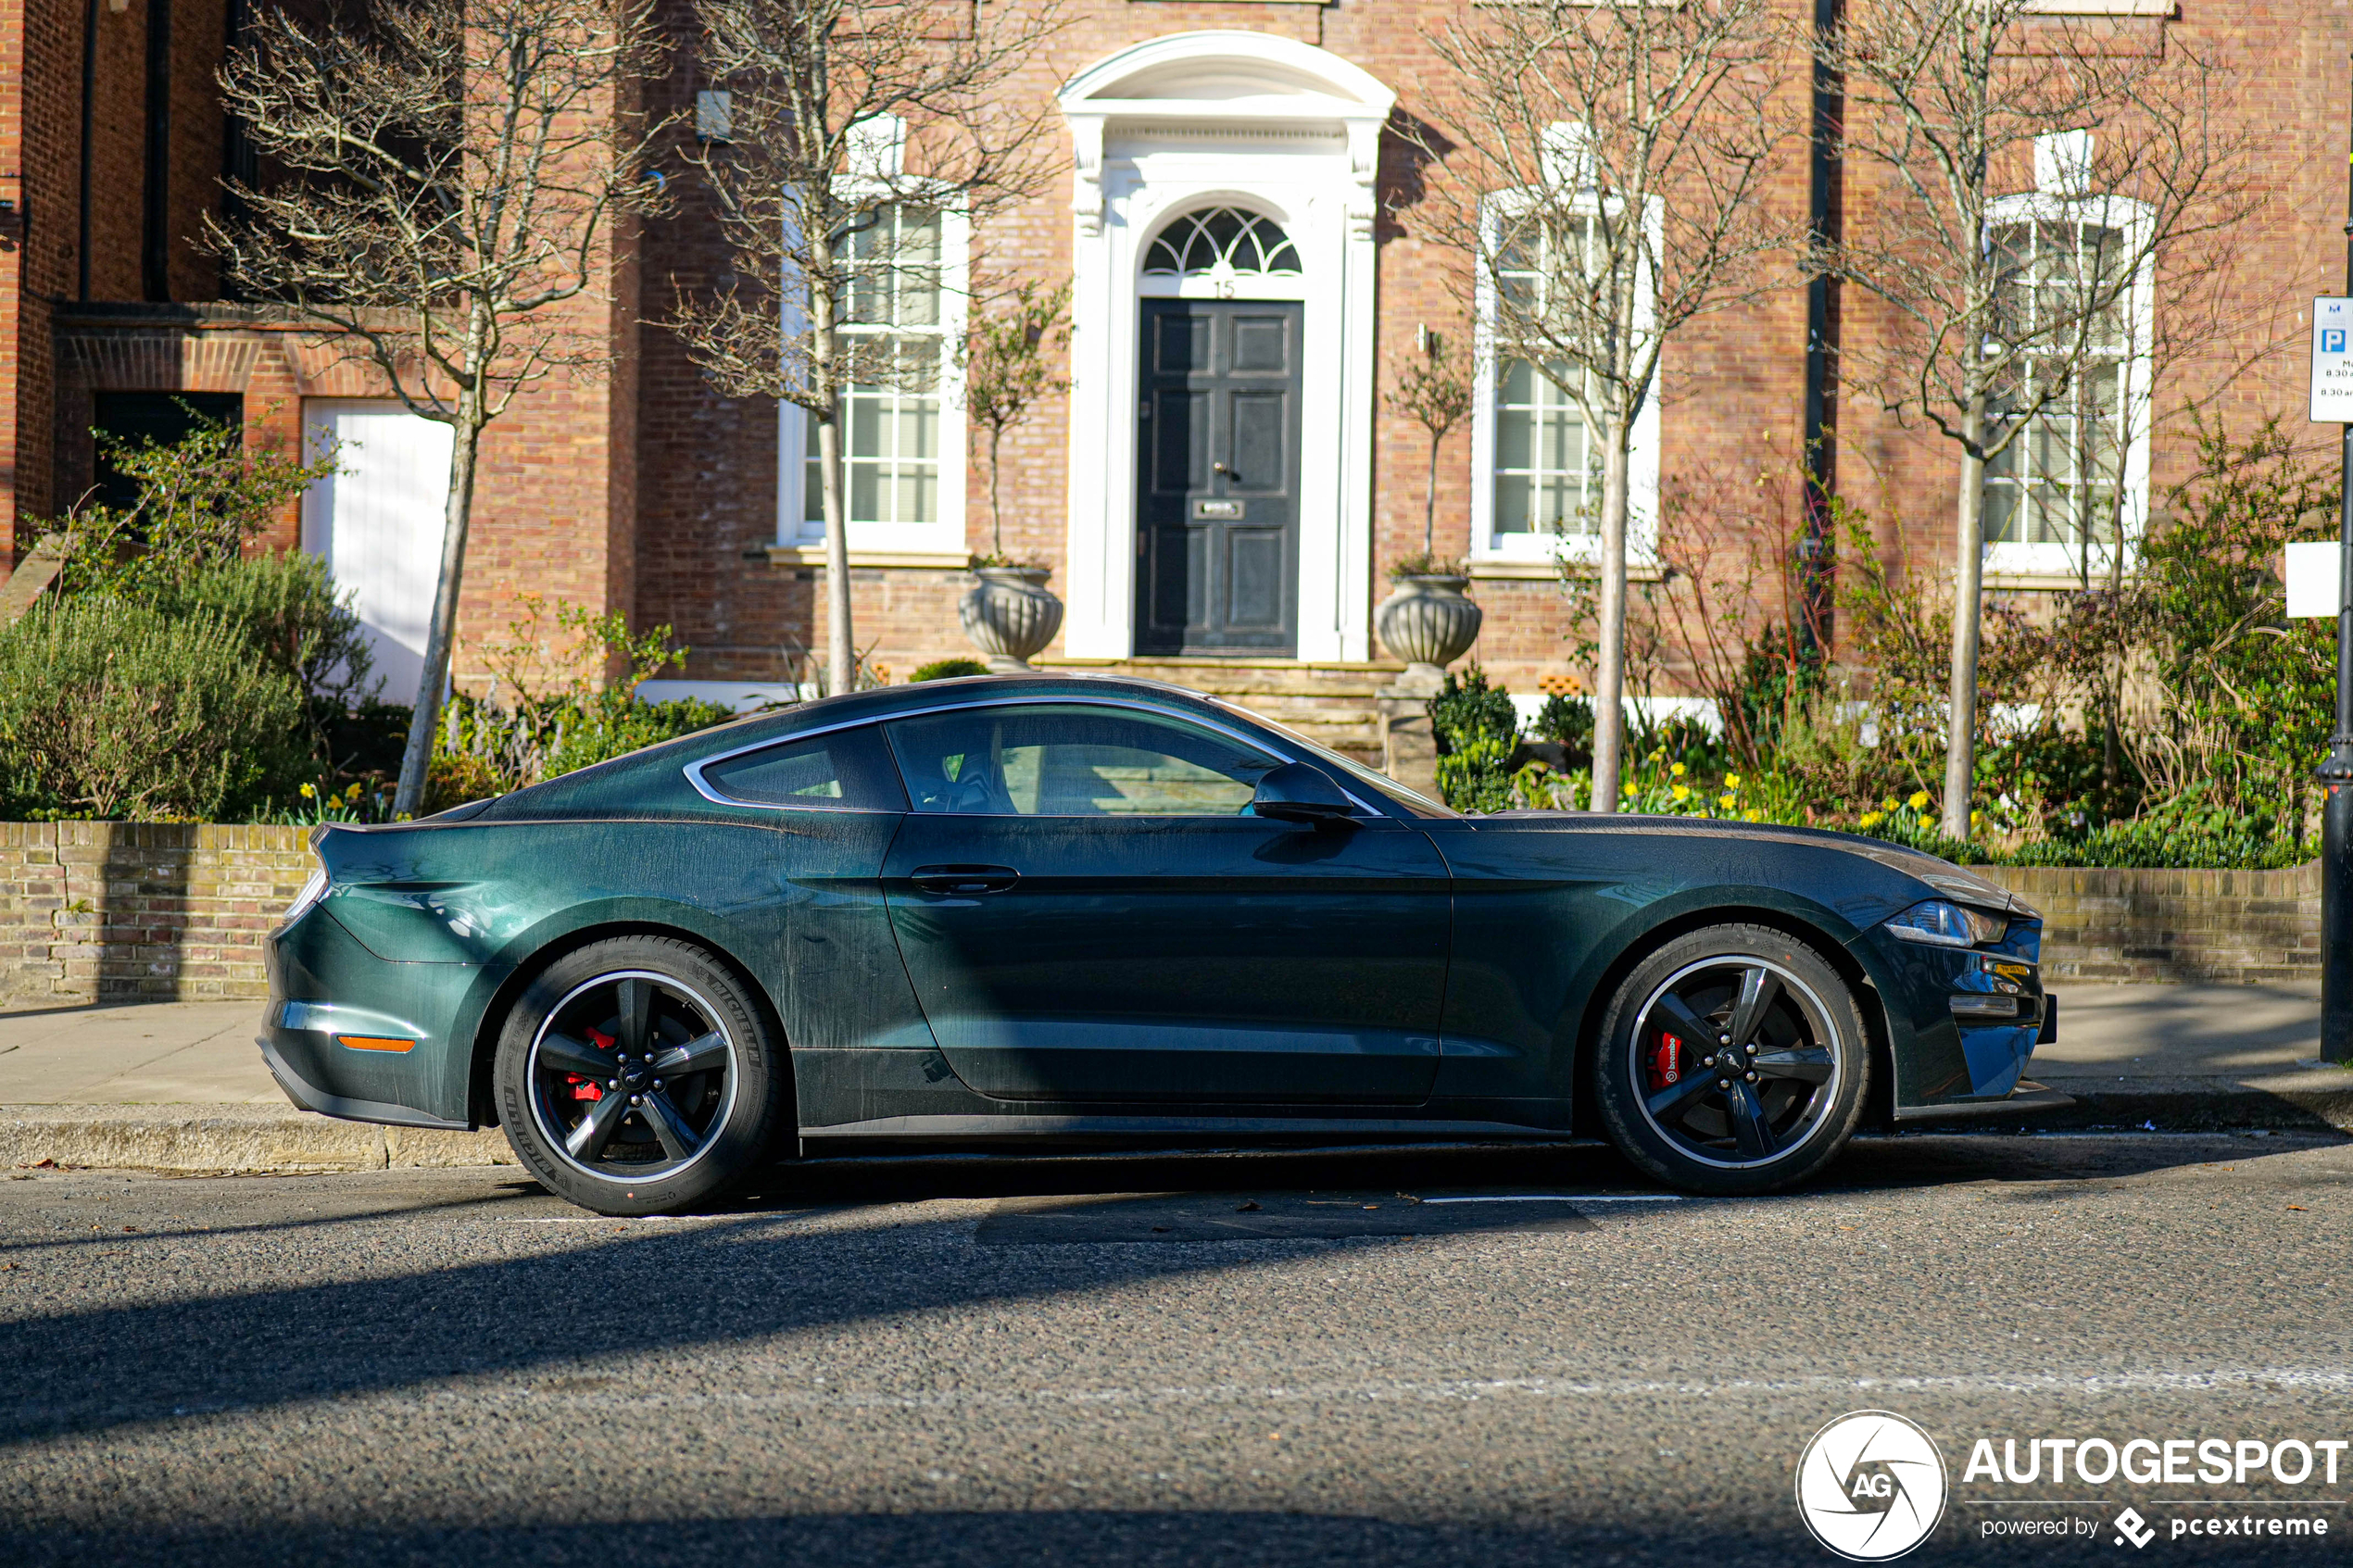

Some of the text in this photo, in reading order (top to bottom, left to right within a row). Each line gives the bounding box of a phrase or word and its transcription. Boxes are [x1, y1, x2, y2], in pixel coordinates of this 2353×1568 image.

[1214, 280, 1235, 299] 15
[2325, 331, 2343, 352] P
[2326, 369, 2348, 379] 8.30
[2321, 387, 2343, 397] 8.30
[710, 981, 761, 1062] MICHELIN
[505, 1051, 514, 1081] 275/40
[512, 1029, 521, 1038] 19
[1667, 1037, 1676, 1070] brembo
[740, 1073, 760, 1135] PILOT SPORT
[506, 1091, 553, 1173] MICHELIN
